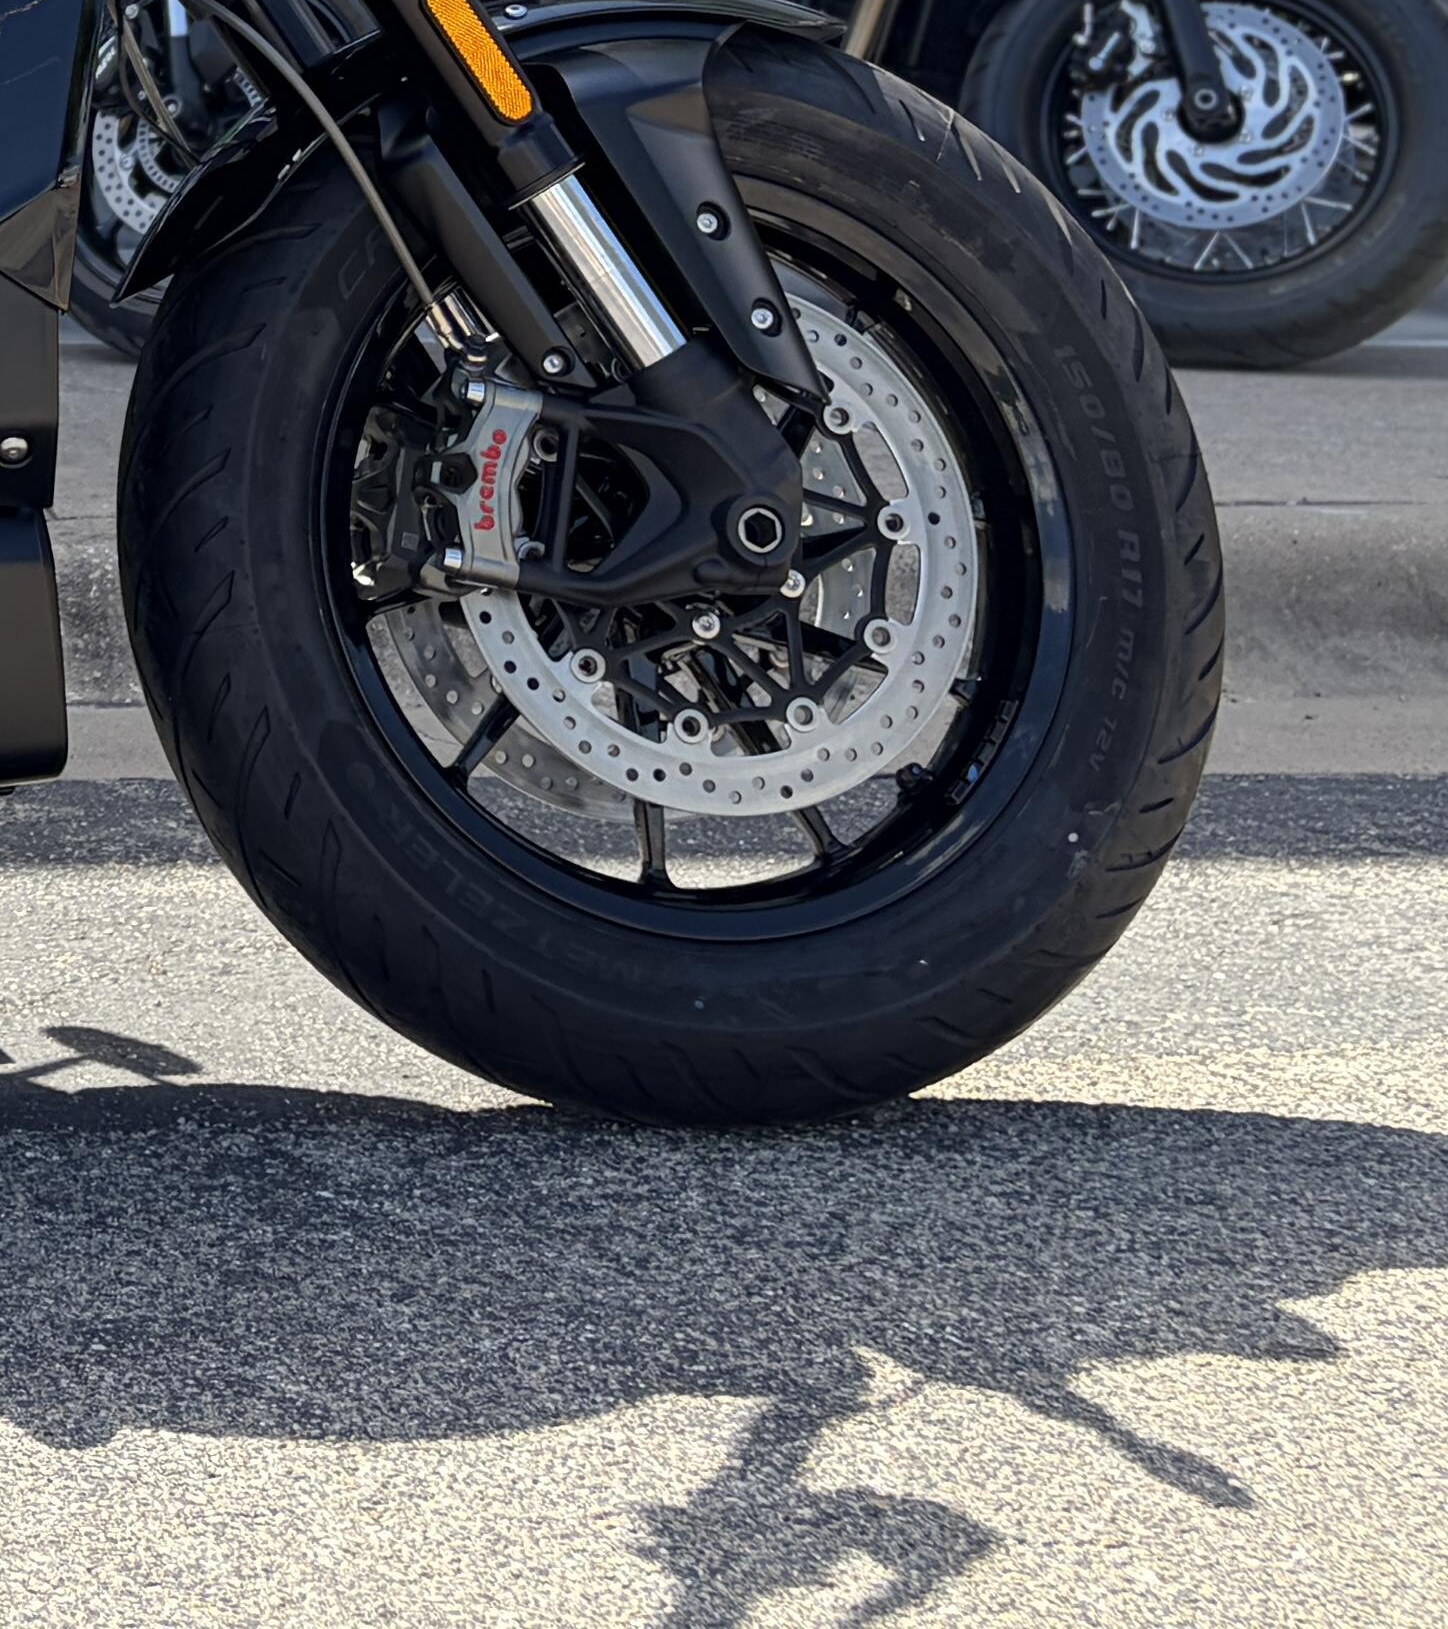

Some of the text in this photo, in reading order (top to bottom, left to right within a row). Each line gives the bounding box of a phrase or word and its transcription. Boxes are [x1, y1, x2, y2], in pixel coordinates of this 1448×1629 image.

[473, 428, 508, 531] brembo
[1052, 344, 1135, 513] 150/80
[1116, 528, 1145, 610] R17
